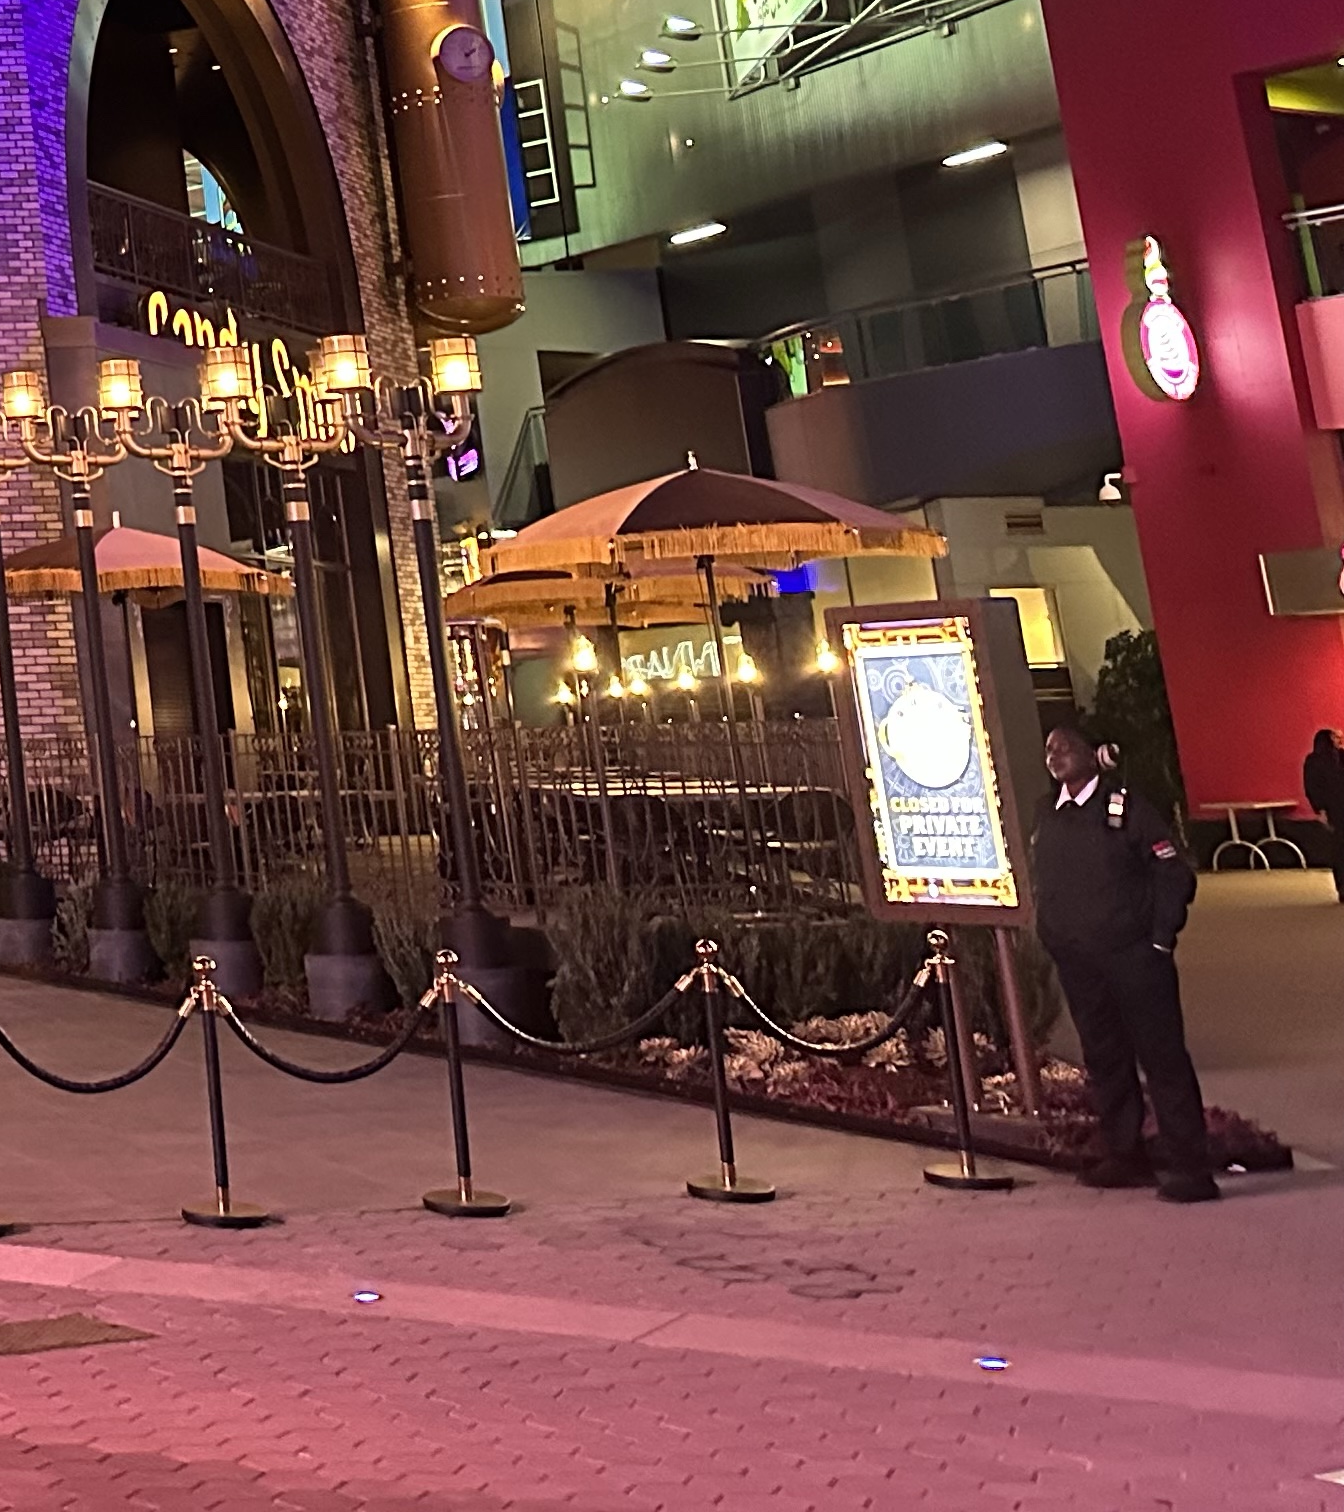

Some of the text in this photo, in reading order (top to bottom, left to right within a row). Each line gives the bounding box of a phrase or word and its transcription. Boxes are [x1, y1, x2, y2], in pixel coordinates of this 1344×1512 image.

[890, 796, 986, 814] CLOSED FOR
[898, 814, 984, 836] PRIVATE
[912, 836, 978, 858] EVENT
